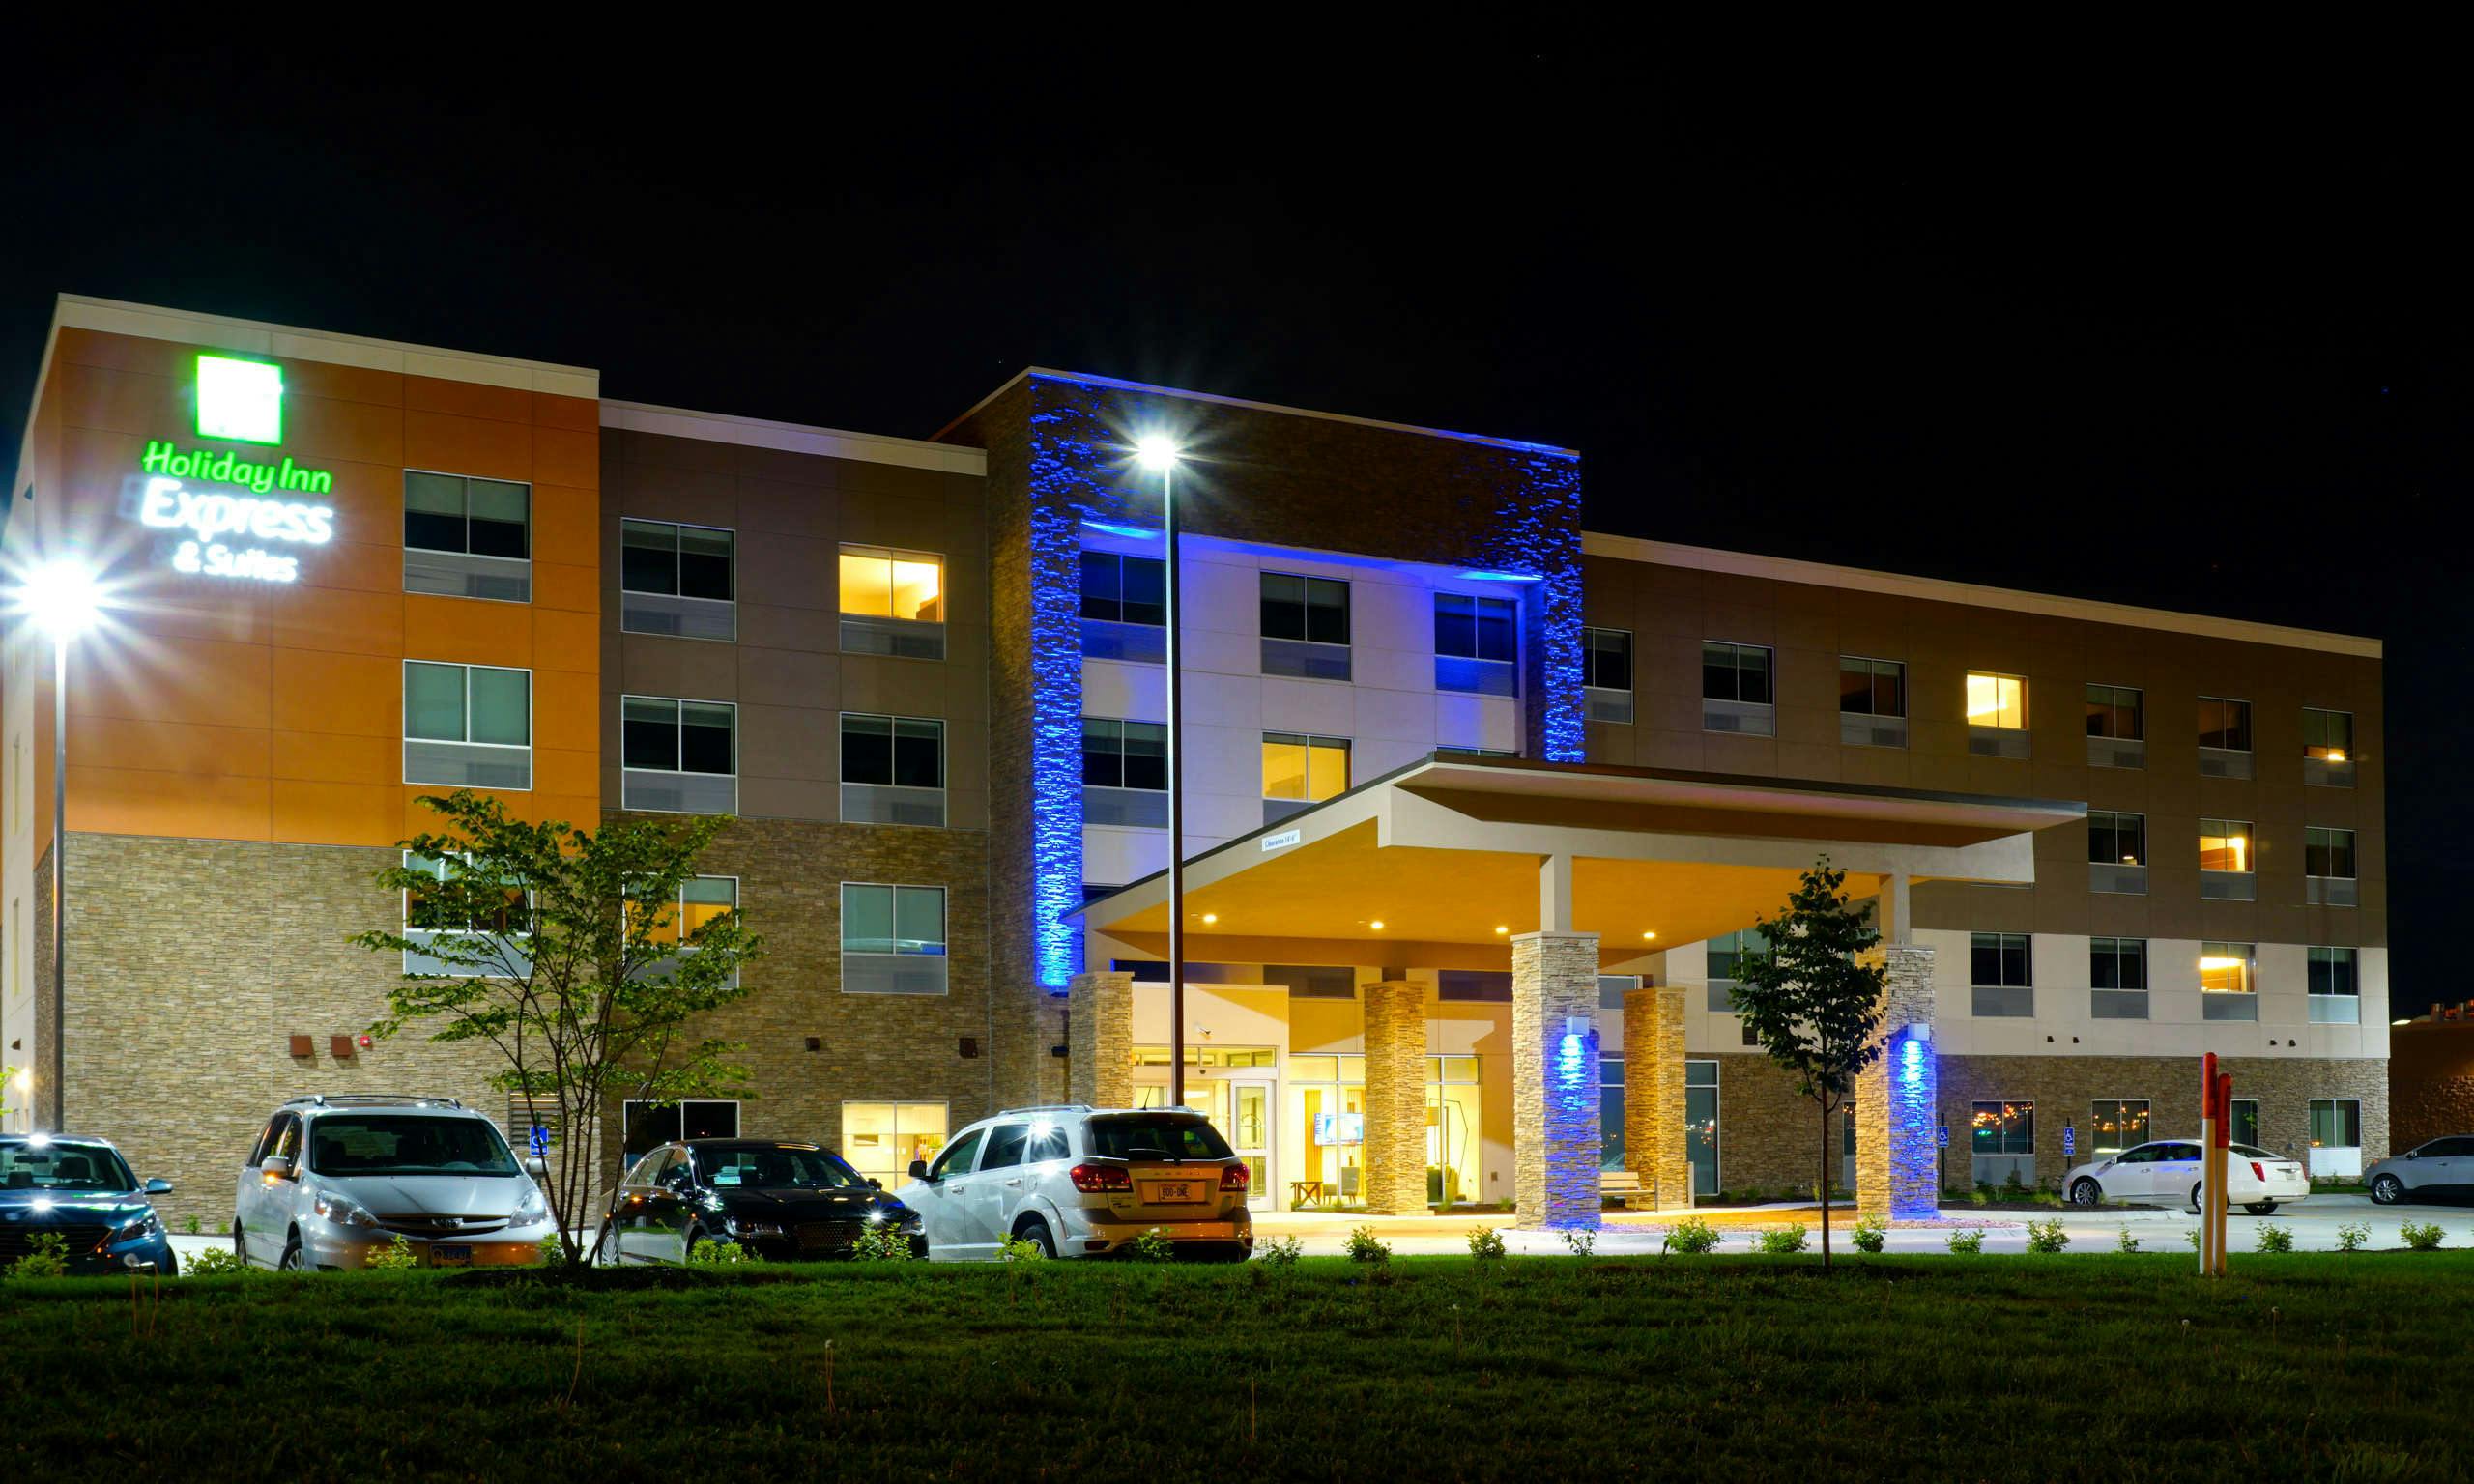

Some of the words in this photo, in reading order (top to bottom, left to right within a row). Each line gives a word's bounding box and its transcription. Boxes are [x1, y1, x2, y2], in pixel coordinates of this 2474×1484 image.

[142, 441, 275, 493] Holiday
[278, 457, 332, 494] Inn
[142, 477, 333, 543] Express
[173, 541, 201, 573] &
[204, 544, 298, 582] Suites
